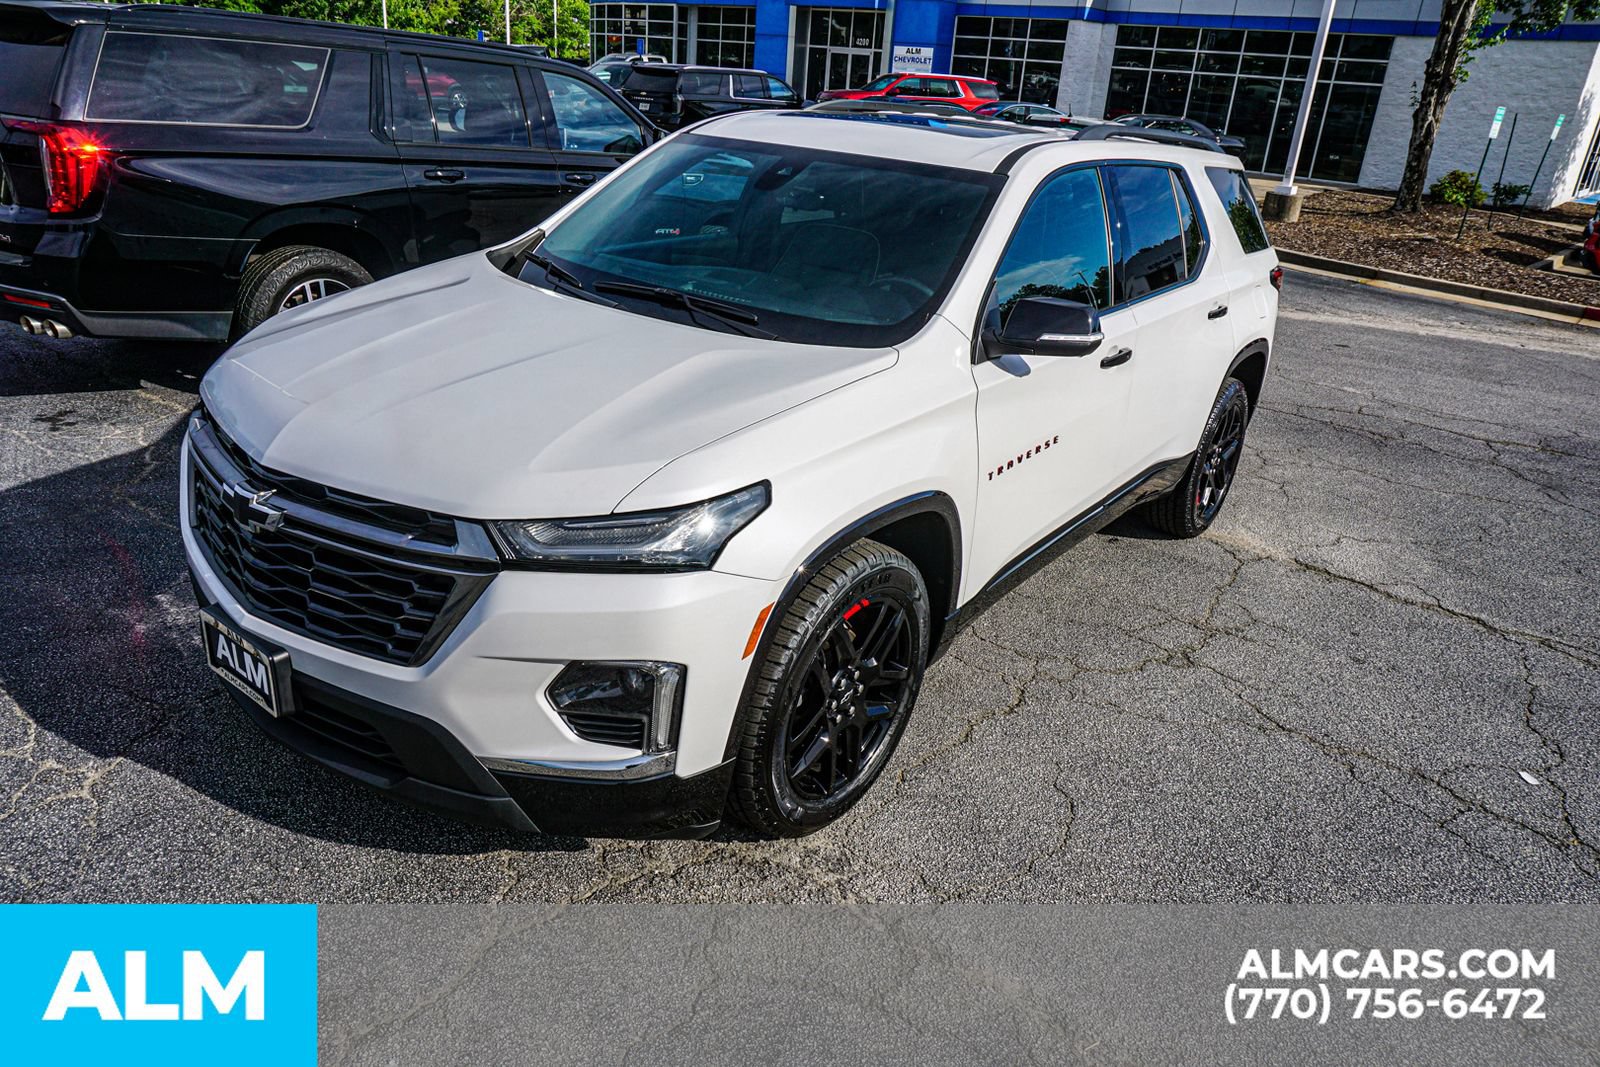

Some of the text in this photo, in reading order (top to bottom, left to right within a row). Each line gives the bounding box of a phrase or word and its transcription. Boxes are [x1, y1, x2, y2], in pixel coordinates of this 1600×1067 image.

[893, 55, 932, 65] CHEVROLET
[905, 47, 922, 55] ALM
[987, 435, 1059, 481] TRAVERSE
[216, 633, 270, 696] ALM
